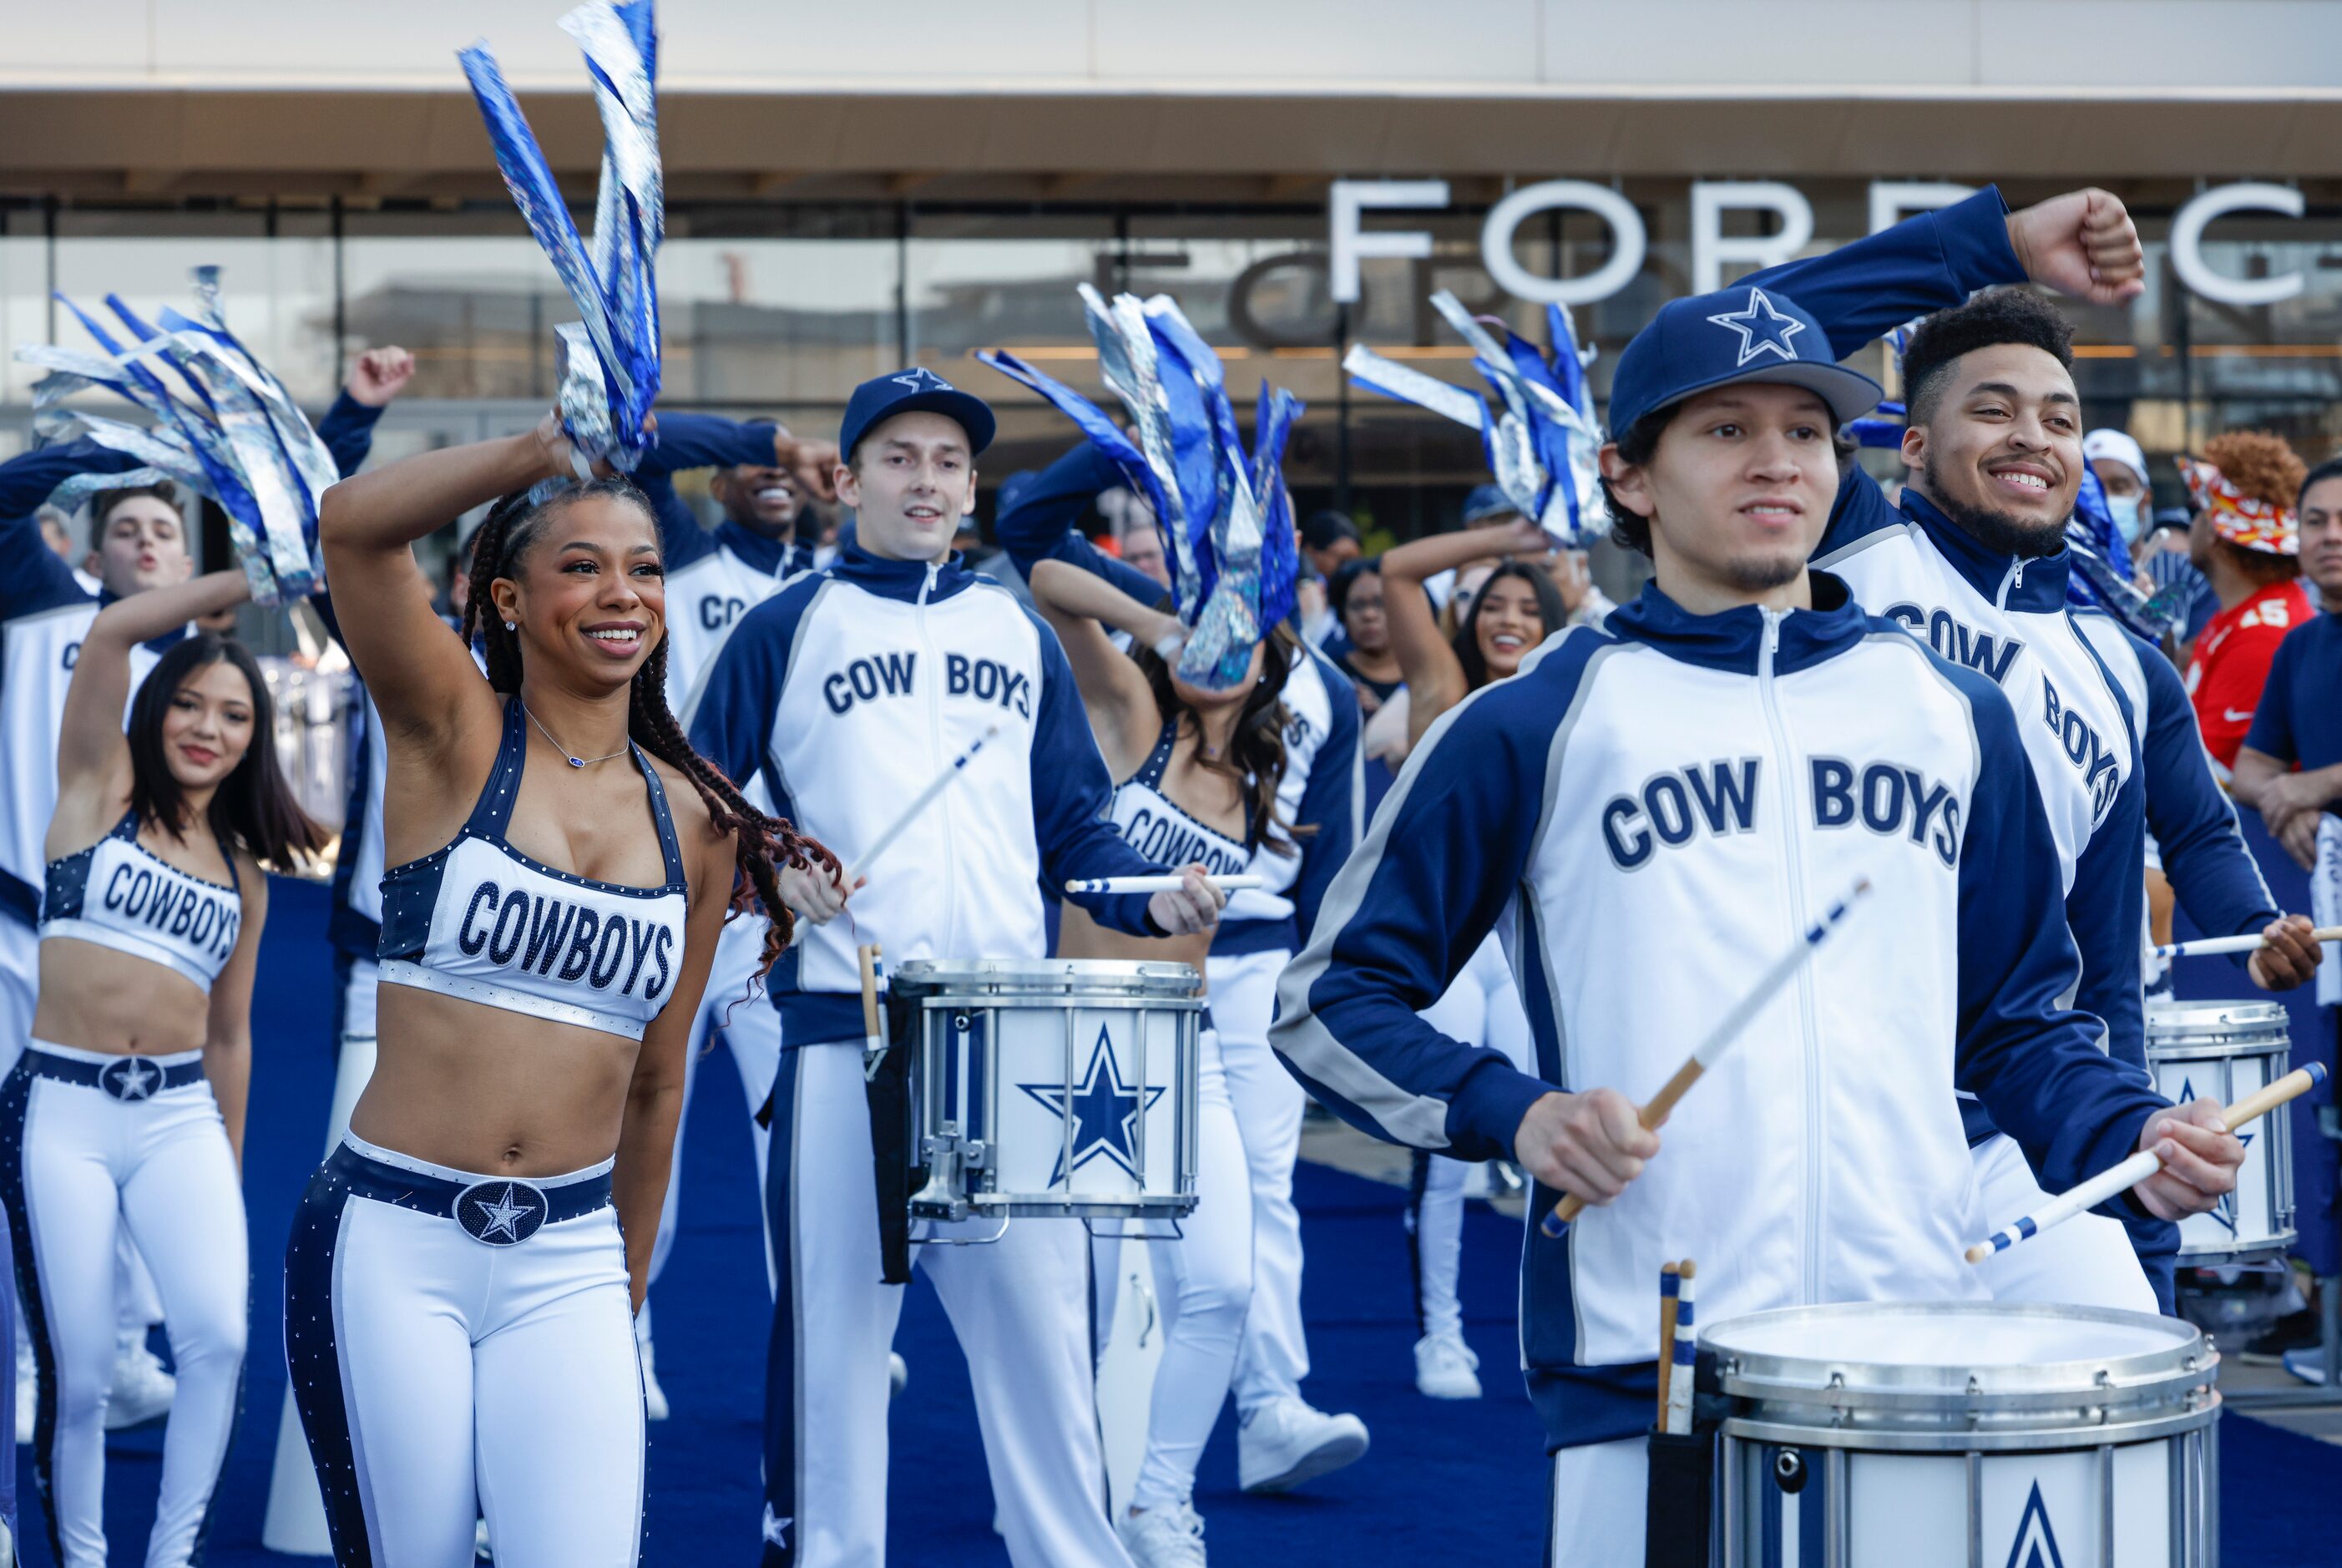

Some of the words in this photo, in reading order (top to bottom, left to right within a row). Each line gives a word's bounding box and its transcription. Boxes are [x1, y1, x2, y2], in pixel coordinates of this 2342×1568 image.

[1331, 180, 2062, 306] FOR
[823, 651, 917, 717] COW
[944, 651, 1029, 721] BOYS
[2041, 668, 2121, 827] BOYS
[1601, 756, 1762, 873] COW
[1807, 755, 1960, 871] BOYS
[105, 862, 237, 961] COWBOYS
[455, 877, 675, 1002] COWBOYS
